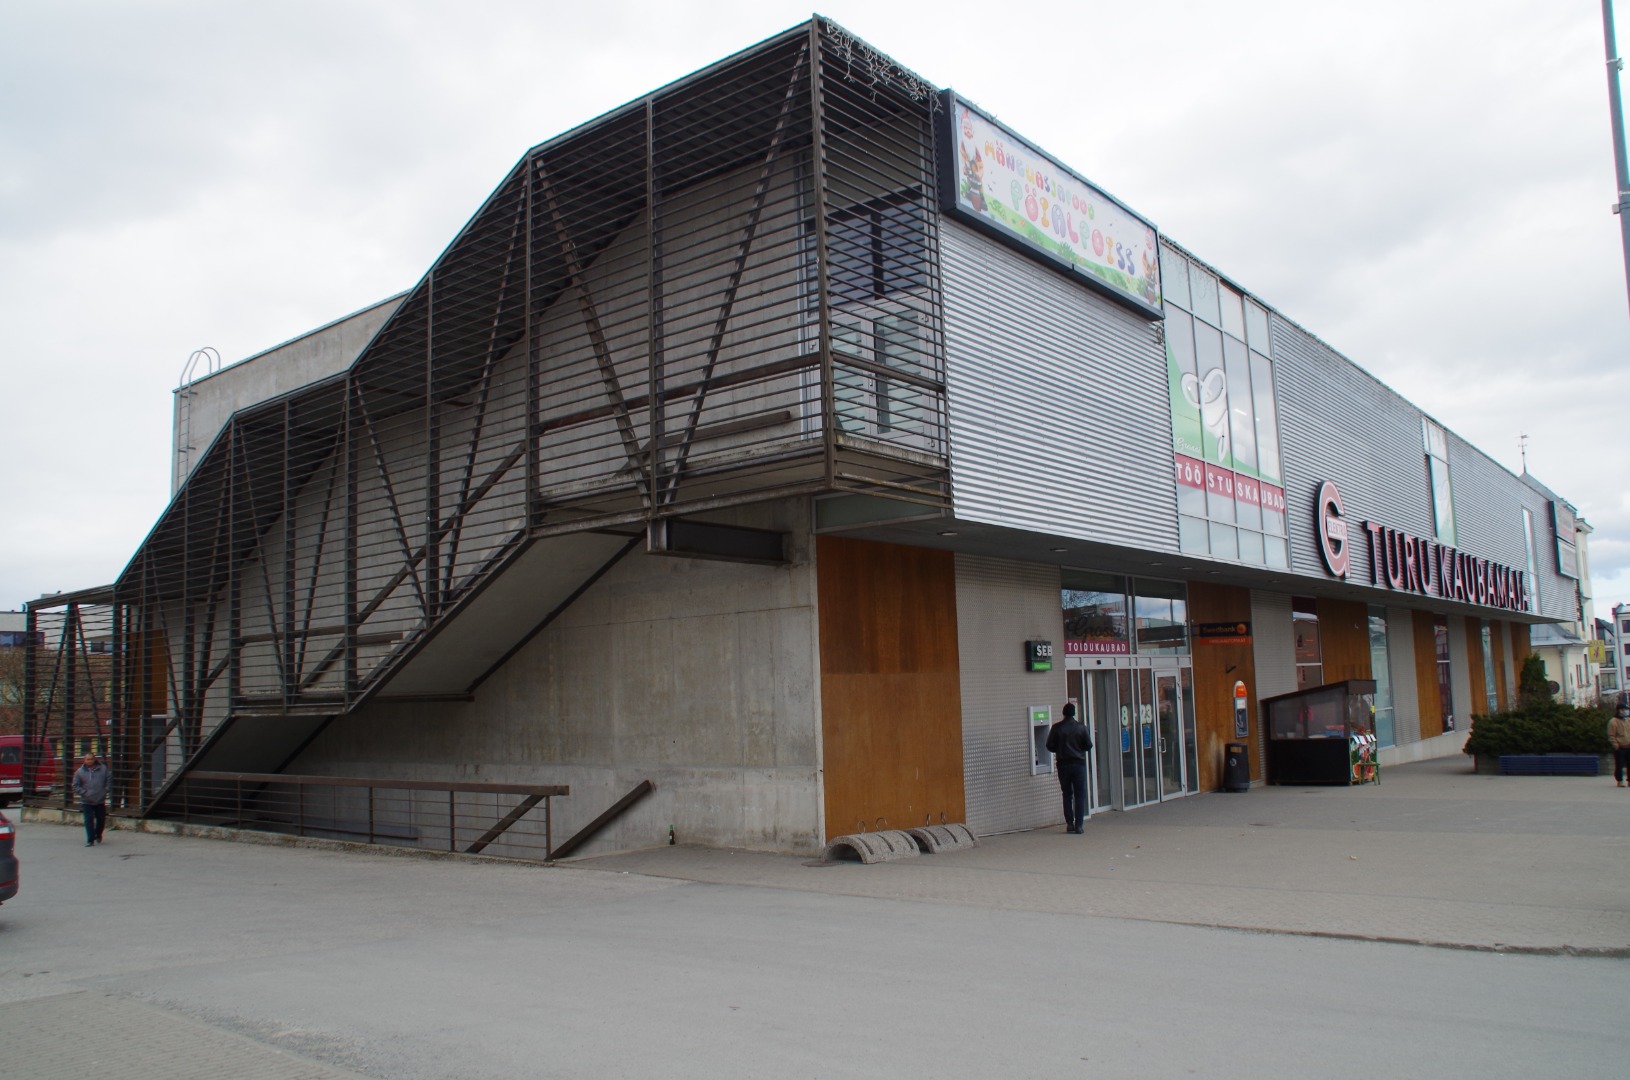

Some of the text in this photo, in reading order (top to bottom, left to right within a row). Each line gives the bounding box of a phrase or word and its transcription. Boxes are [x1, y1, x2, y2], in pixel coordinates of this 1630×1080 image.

[984, 140, 1095, 220] MÄNGUASJAPOOD
[1010, 179, 1136, 276] PÖIALPOISS
[1361, 520, 1432, 594] TURU
[1436, 544, 1530, 612] KAUBAMAJA
[1036, 644, 1053, 657] SEB
[1068, 642, 1126, 652] TOIDUKAUBAD
[1121, 705, 1129, 726] 8
